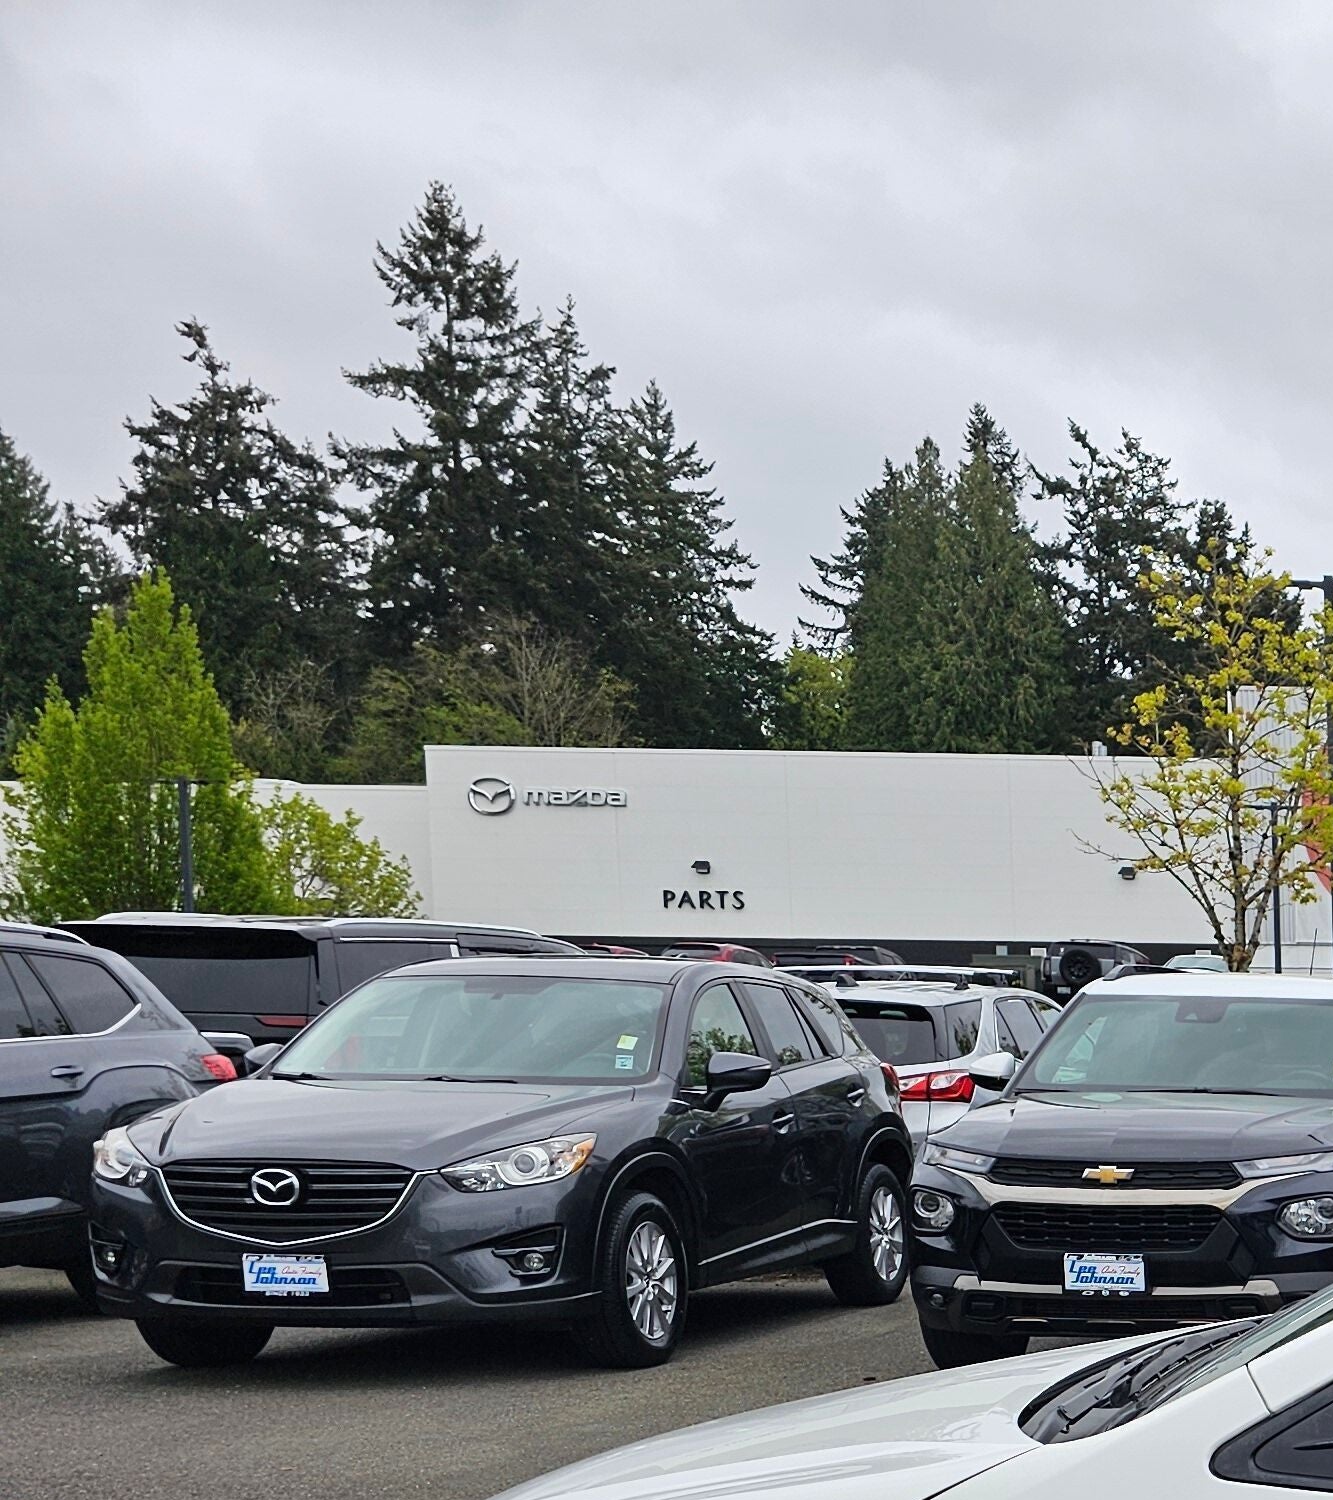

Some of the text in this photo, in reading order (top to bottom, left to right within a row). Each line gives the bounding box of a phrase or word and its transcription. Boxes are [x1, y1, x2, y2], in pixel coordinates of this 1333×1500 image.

[523, 786, 627, 807] mazda
[662, 889, 745, 910] PARTS
[249, 1261, 277, 1274] Lee
[1069, 1260, 1098, 1274] Lee
[251, 1271, 318, 1285] Johnson
[1071, 1270, 1136, 1285] Johnson
